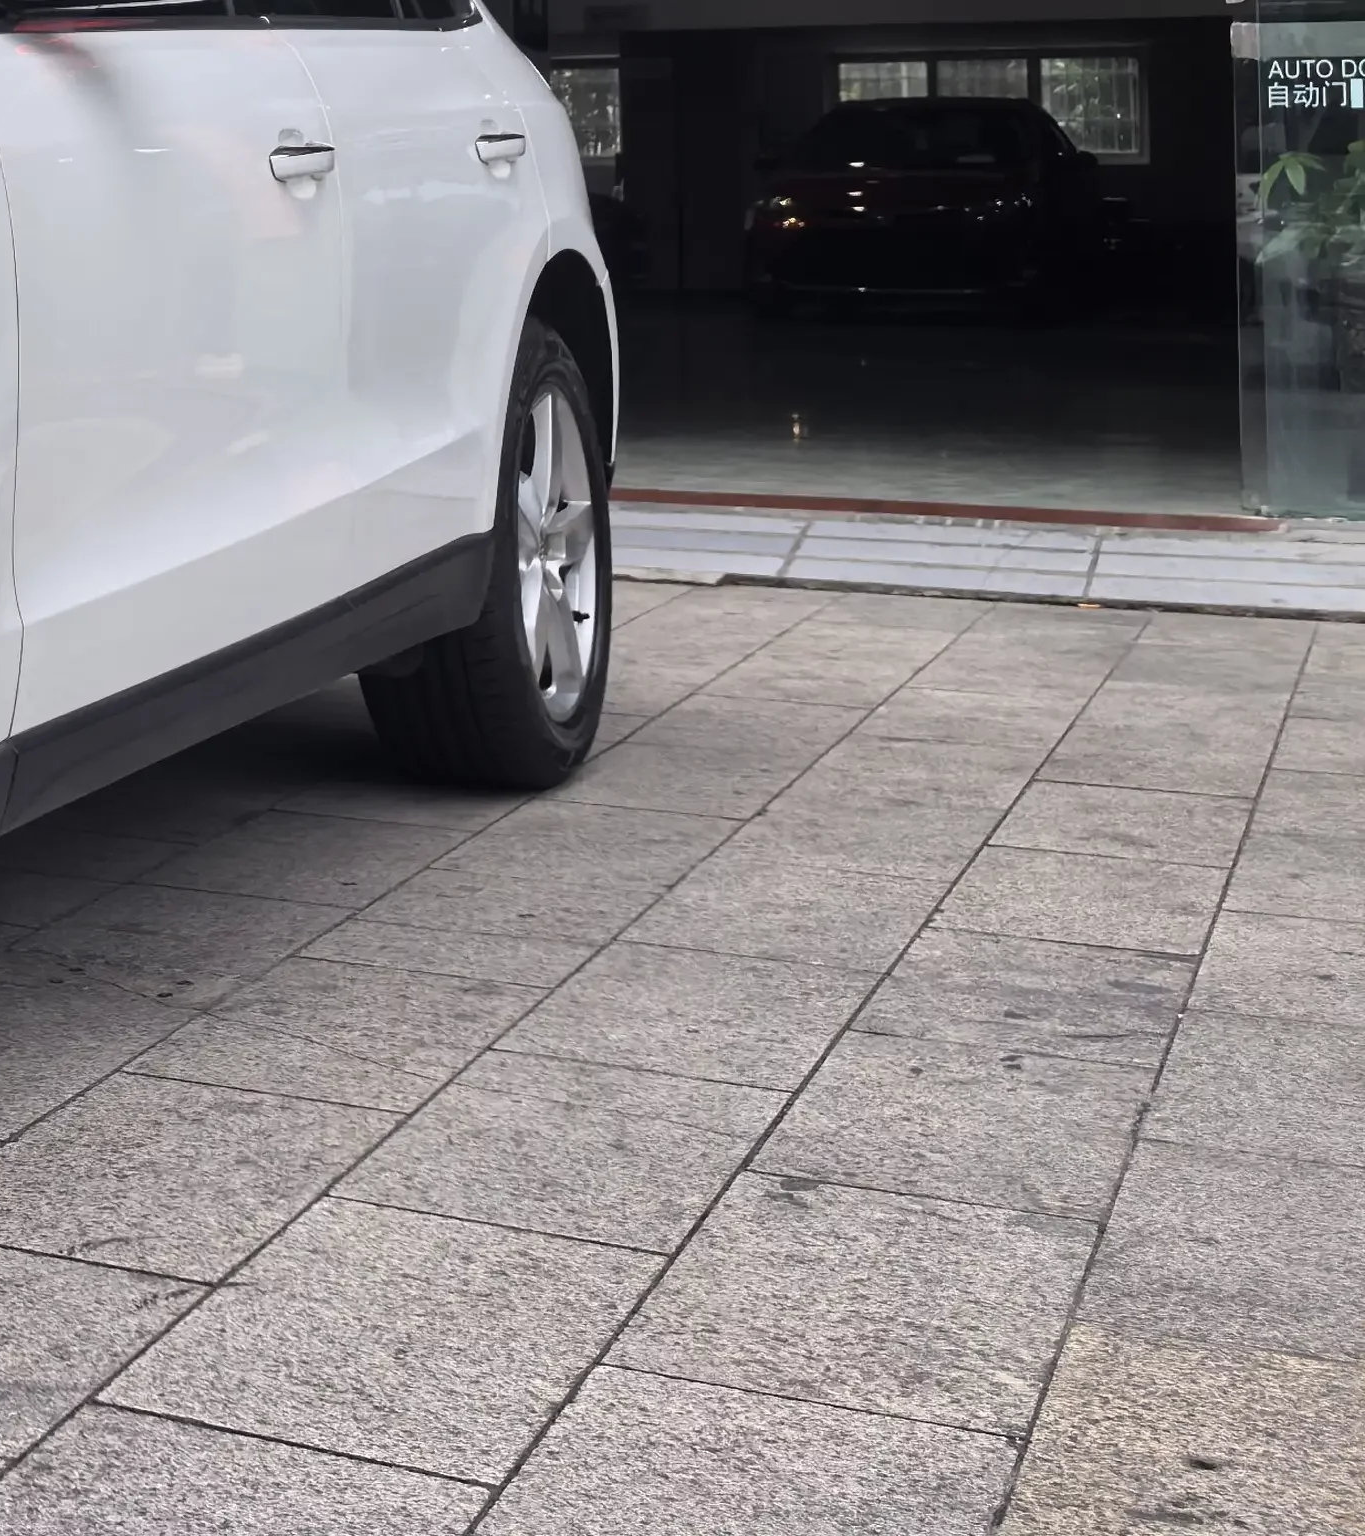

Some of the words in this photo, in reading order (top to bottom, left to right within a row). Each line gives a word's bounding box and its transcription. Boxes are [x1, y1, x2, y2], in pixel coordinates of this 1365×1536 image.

[1268, 58, 1334, 79] AUTO
[1268, 81, 1348, 108] 自动门
